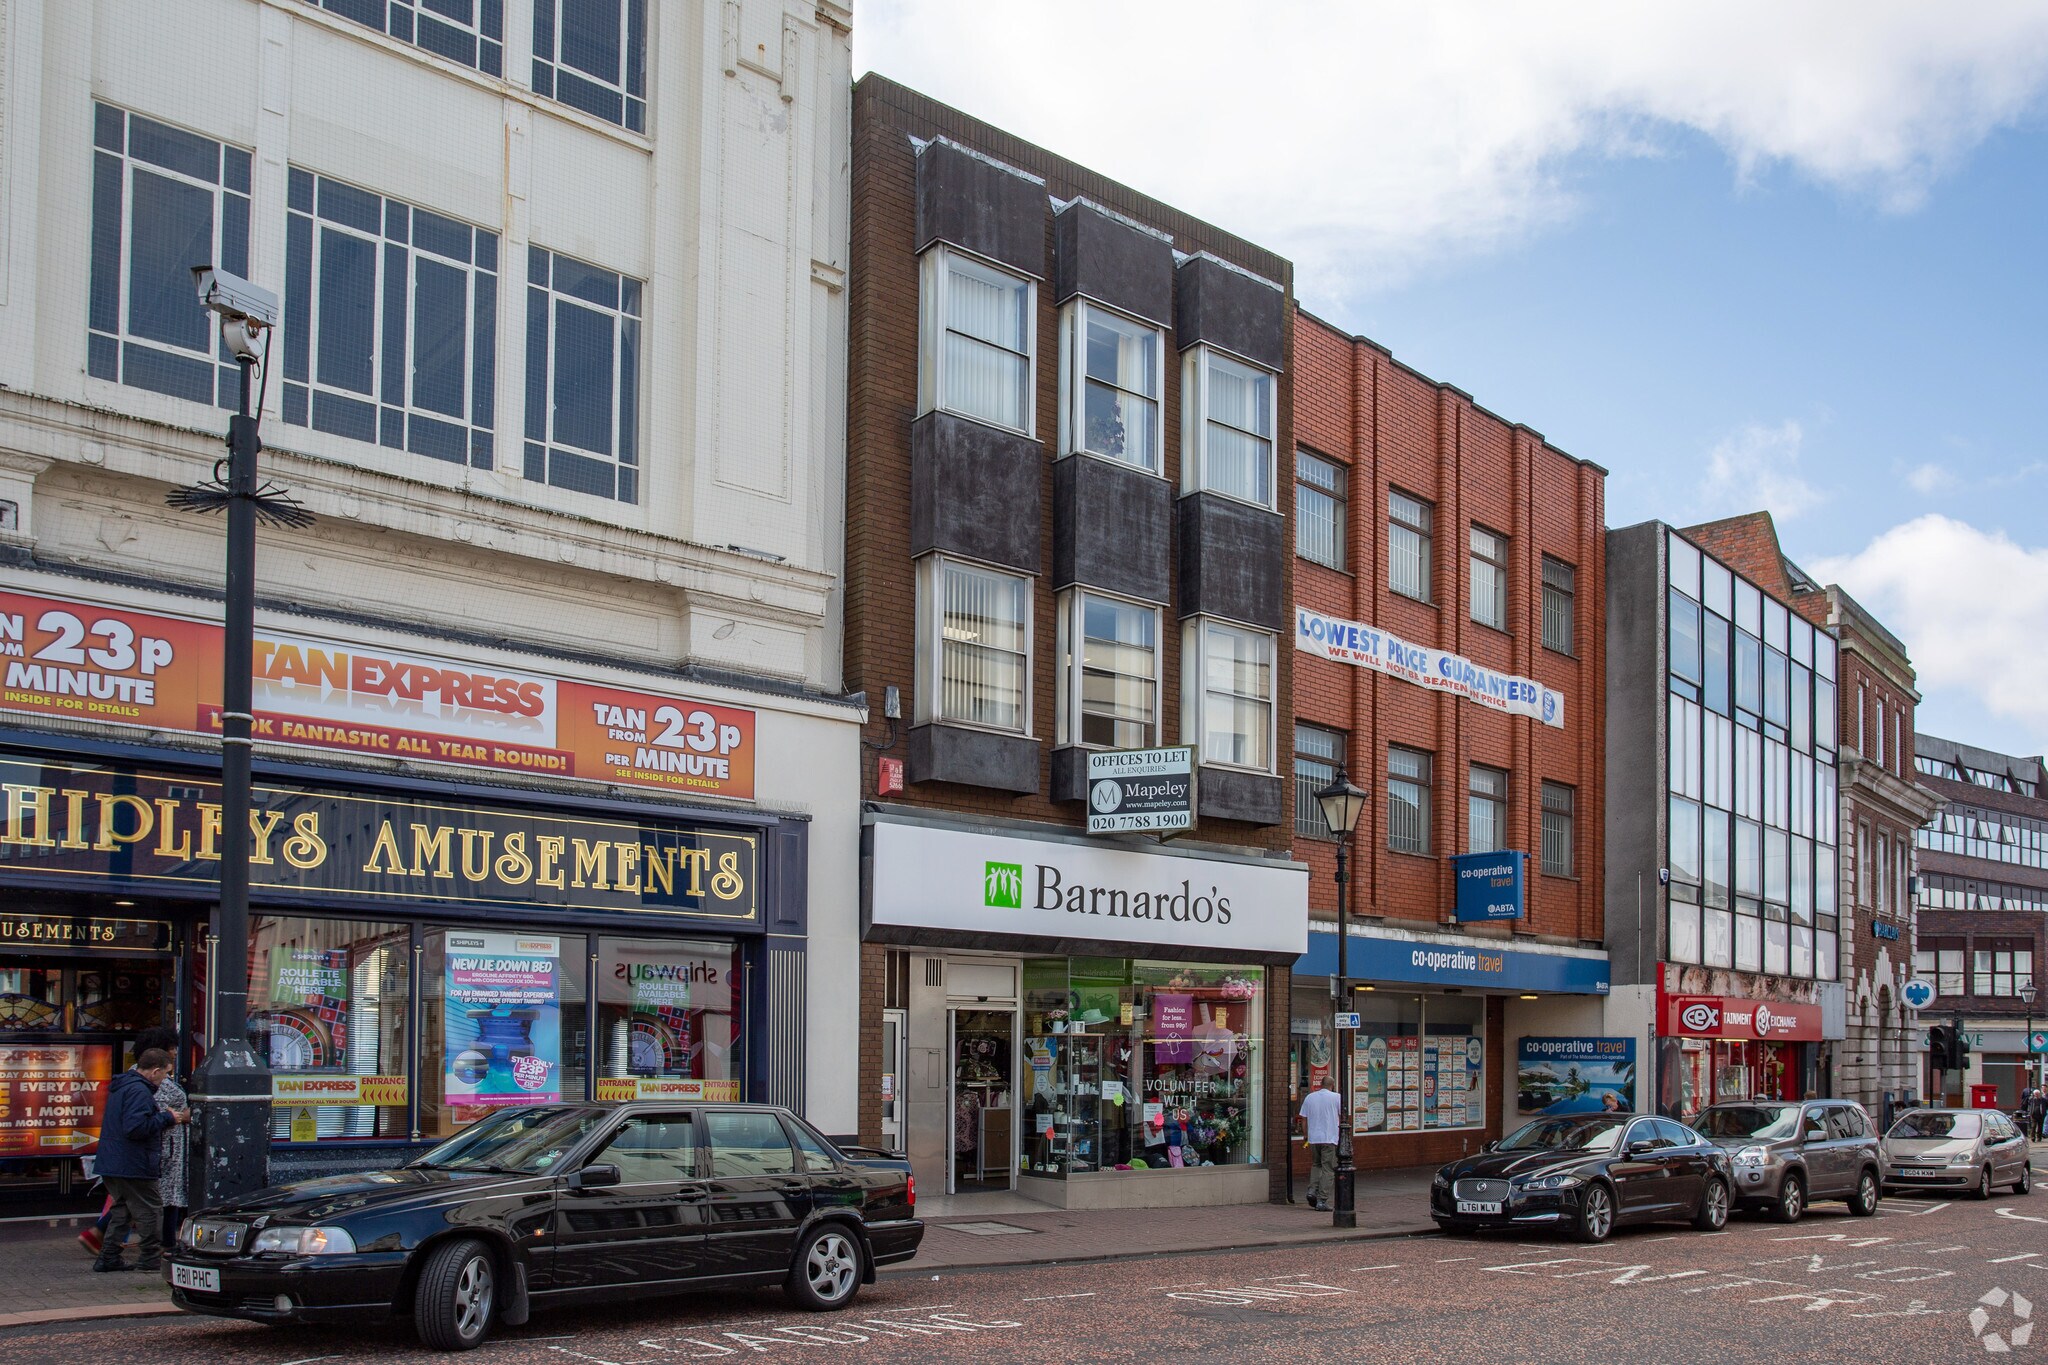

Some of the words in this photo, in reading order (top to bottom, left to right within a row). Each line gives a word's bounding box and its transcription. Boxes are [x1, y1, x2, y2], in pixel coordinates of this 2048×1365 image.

[32, 611, 173, 675] 23p
[1299, 612, 1381, 656] LOWEST
[1388, 638, 1428, 674] PRICE
[5, 661, 155, 705] MINUTE
[1328, 646, 1349, 659] WE
[1352, 651, 1381, 667] WILL
[1386, 661, 1406, 676] NOT
[1407, 669, 1420, 681] BE
[1423, 675, 1469, 693] BEATEN
[1469, 689, 1479, 702] IN
[1481, 693, 1507, 709] PRICE
[352, 656, 545, 718] EXPRESS
[4, 691, 52, 706] INSIDE
[56, 698, 83, 710] FOR
[88, 702, 140, 717] DETAILS
[593, 702, 647, 731] TAN
[651, 705, 741, 756] 23p
[608, 728, 647, 744] FROM
[282, 721, 390, 749] FANTASTIC
[396, 736, 432, 754] ALL
[438, 741, 488, 761] YEAR
[493, 746, 567, 771] ROUND!
[605, 752, 630, 767] PER
[634, 747, 730, 780] MINUTE
[1092, 754, 1143, 768] OFFICES
[1145, 752, 1162, 764] TO
[1164, 750, 1188, 763] LET
[1127, 765, 1167, 775] ENQUIRIES
[615, 768, 632, 779] SEE
[634, 770, 664, 783] INSIDE
[666, 774, 684, 785] FOR
[686, 776, 720, 790] DETAILS
[1125, 780, 1188, 800] Mapeley
[1126, 799, 1188, 809] www.mapeley.com
[1092, 817, 1115, 830] 020
[1119, 815, 1151, 829] 7788
[1156, 814, 1187, 827] 1900
[0, 783, 328, 870] HIPLEYS
[363, 818, 745, 900] AMUSEMENTS
[1490, 876, 1514, 888] travel
[1033, 864, 1233, 926] Barnardo's
[1495, 903, 1515, 913] ABTA
[1, 921, 116, 942] USEMENTS
[452, 958, 478, 971] NEW
[480, 959, 496, 971] LIE
[496, 960, 531, 972] DOWN
[532, 961, 553, 973] BED
[1478, 953, 1503, 973] travel
[280, 968, 340, 978] ROULETTE
[277, 977, 341, 987] AVAILABLE
[639, 983, 684, 991] ROULETTE
[294, 986, 325, 995] HERE
[450, 989, 462, 997] FOR
[523, 991, 555, 999] EXPERIENCE
[637, 990, 686, 998] AVAILABLE
[1723, 1012, 1752, 1026] TAINMENT
[1771, 1016, 1797, 1028] EXCHANGE
[1596, 1040, 1626, 1053] travel
[511, 1056, 532, 1065] STILL
[532, 1059, 554, 1068] ONLY
[20, 1081, 66, 1092] EVERY
[70, 1081, 100, 1092] DAY
[361, 1077, 406, 1085] ENTRANCE
[599, 1079, 636, 1087] ENTRANCE
[704, 1081, 738, 1089] ENTRANCE
[1146, 1079, 1217, 1094] VOLUNTEER
[48, 1094, 72, 1103] FOR
[1163, 1095, 1197, 1108] WITH
[25, 1107, 32, 1116] 1
[39, 1106, 94, 1117] MONTH
[1172, 1109, 1187, 1120] US
[15, 1119, 42, 1127] MON
[58, 1118, 79, 1126] SAT
[43, 1136, 90, 1144] ENTRANCE
[1461, 1203, 1478, 1212] LT61
[1479, 1203, 1496, 1212] WLV
[193, 1268, 213, 1290] PHC
